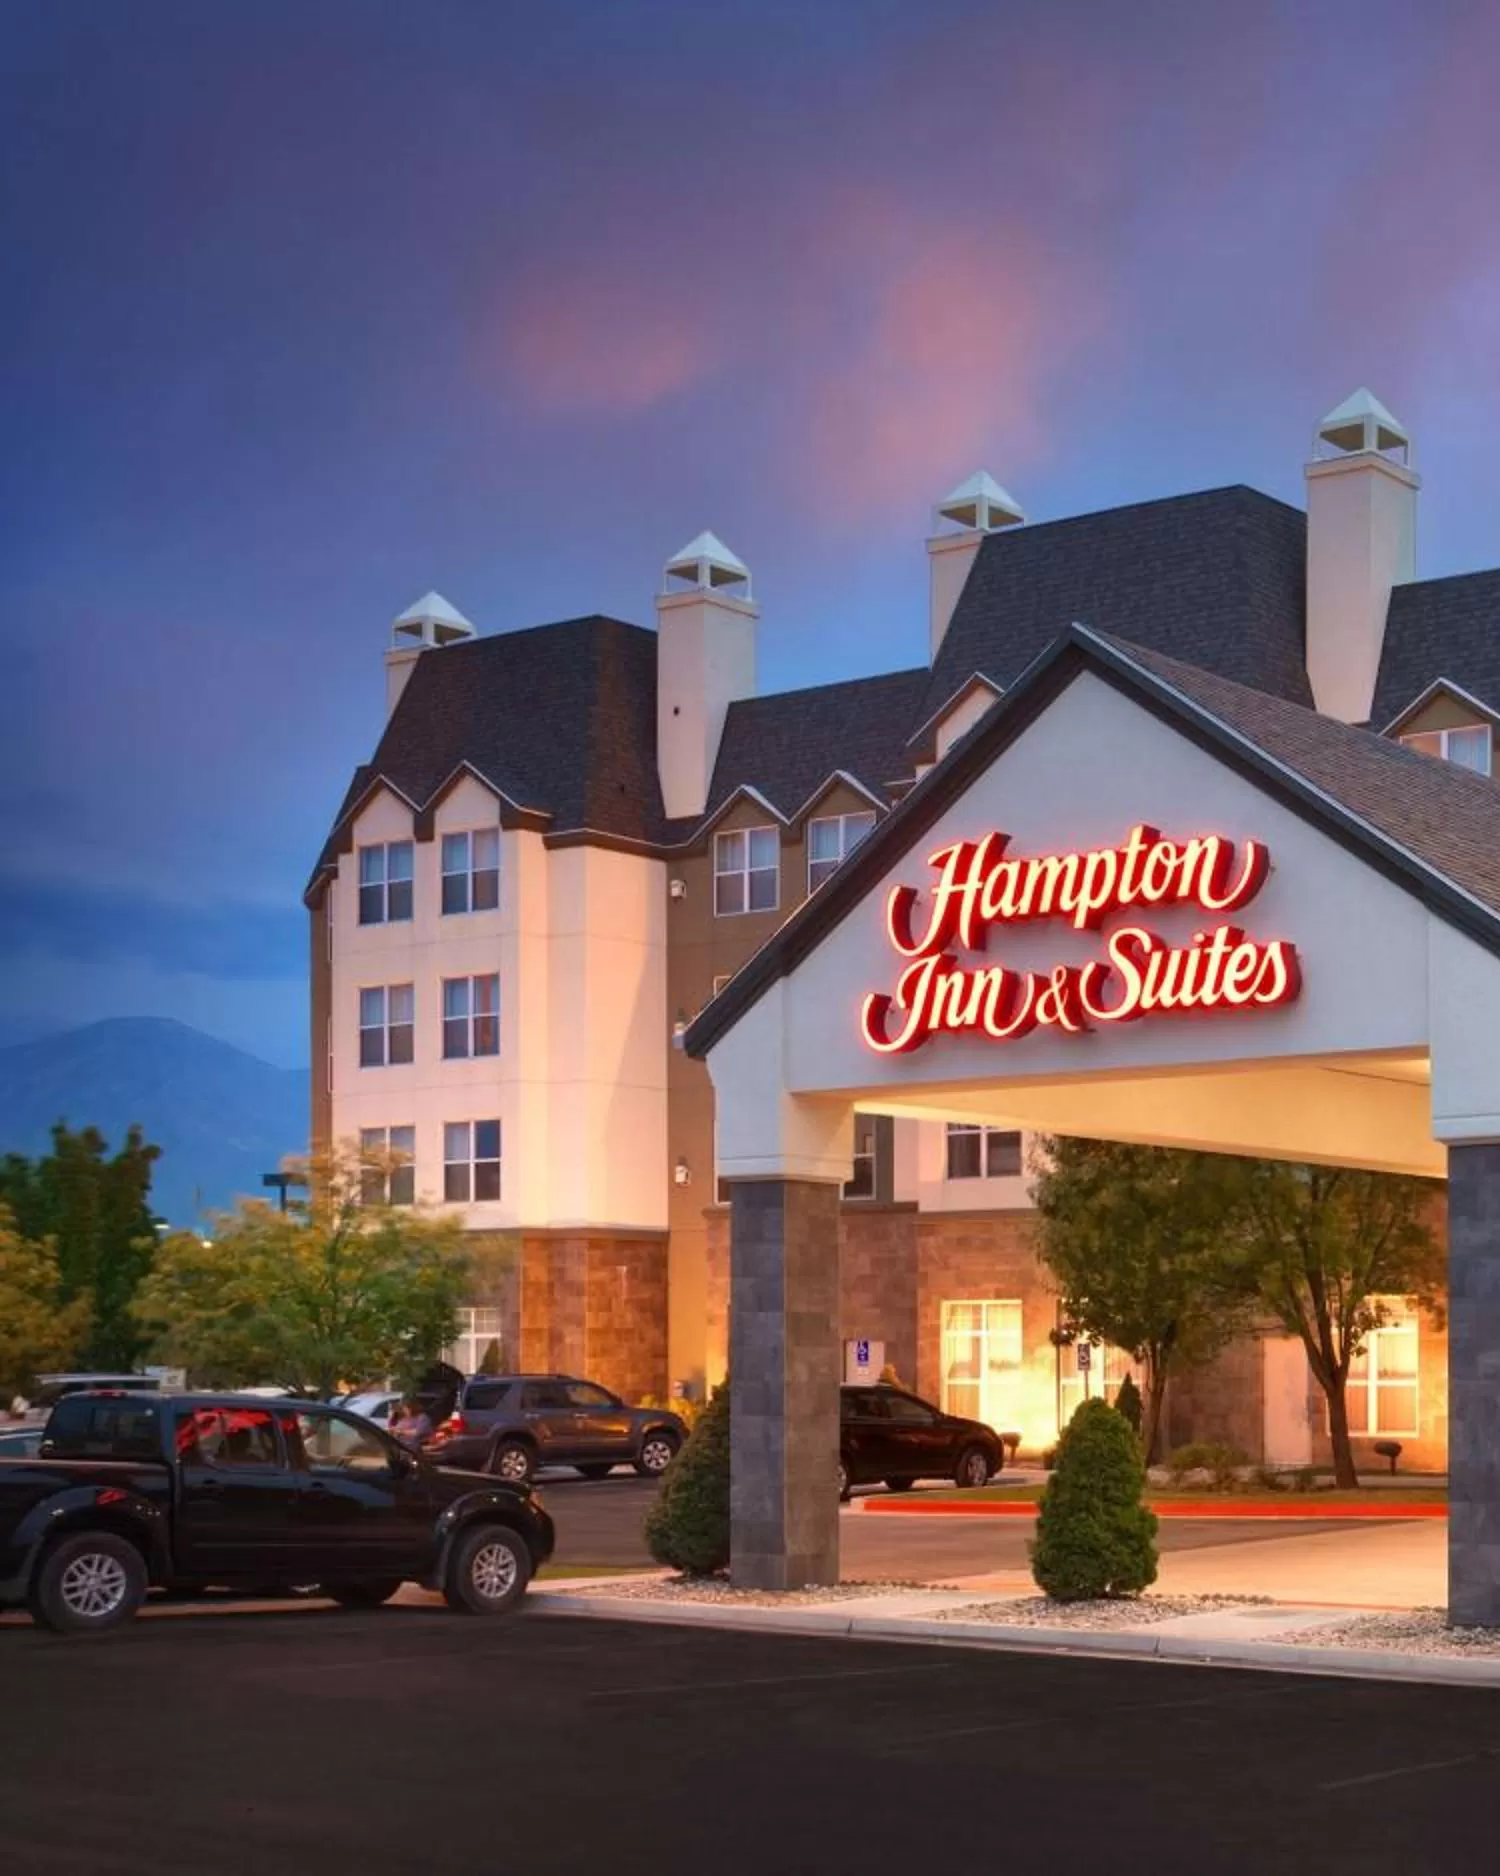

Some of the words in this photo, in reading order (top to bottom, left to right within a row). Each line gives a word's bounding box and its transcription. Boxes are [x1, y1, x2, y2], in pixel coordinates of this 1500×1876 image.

[887, 823, 1270, 957] Hampton
[861, 953, 1035, 1052] Inn
[1035, 965, 1082, 1032] &
[1080, 925, 1302, 1021] Suites
